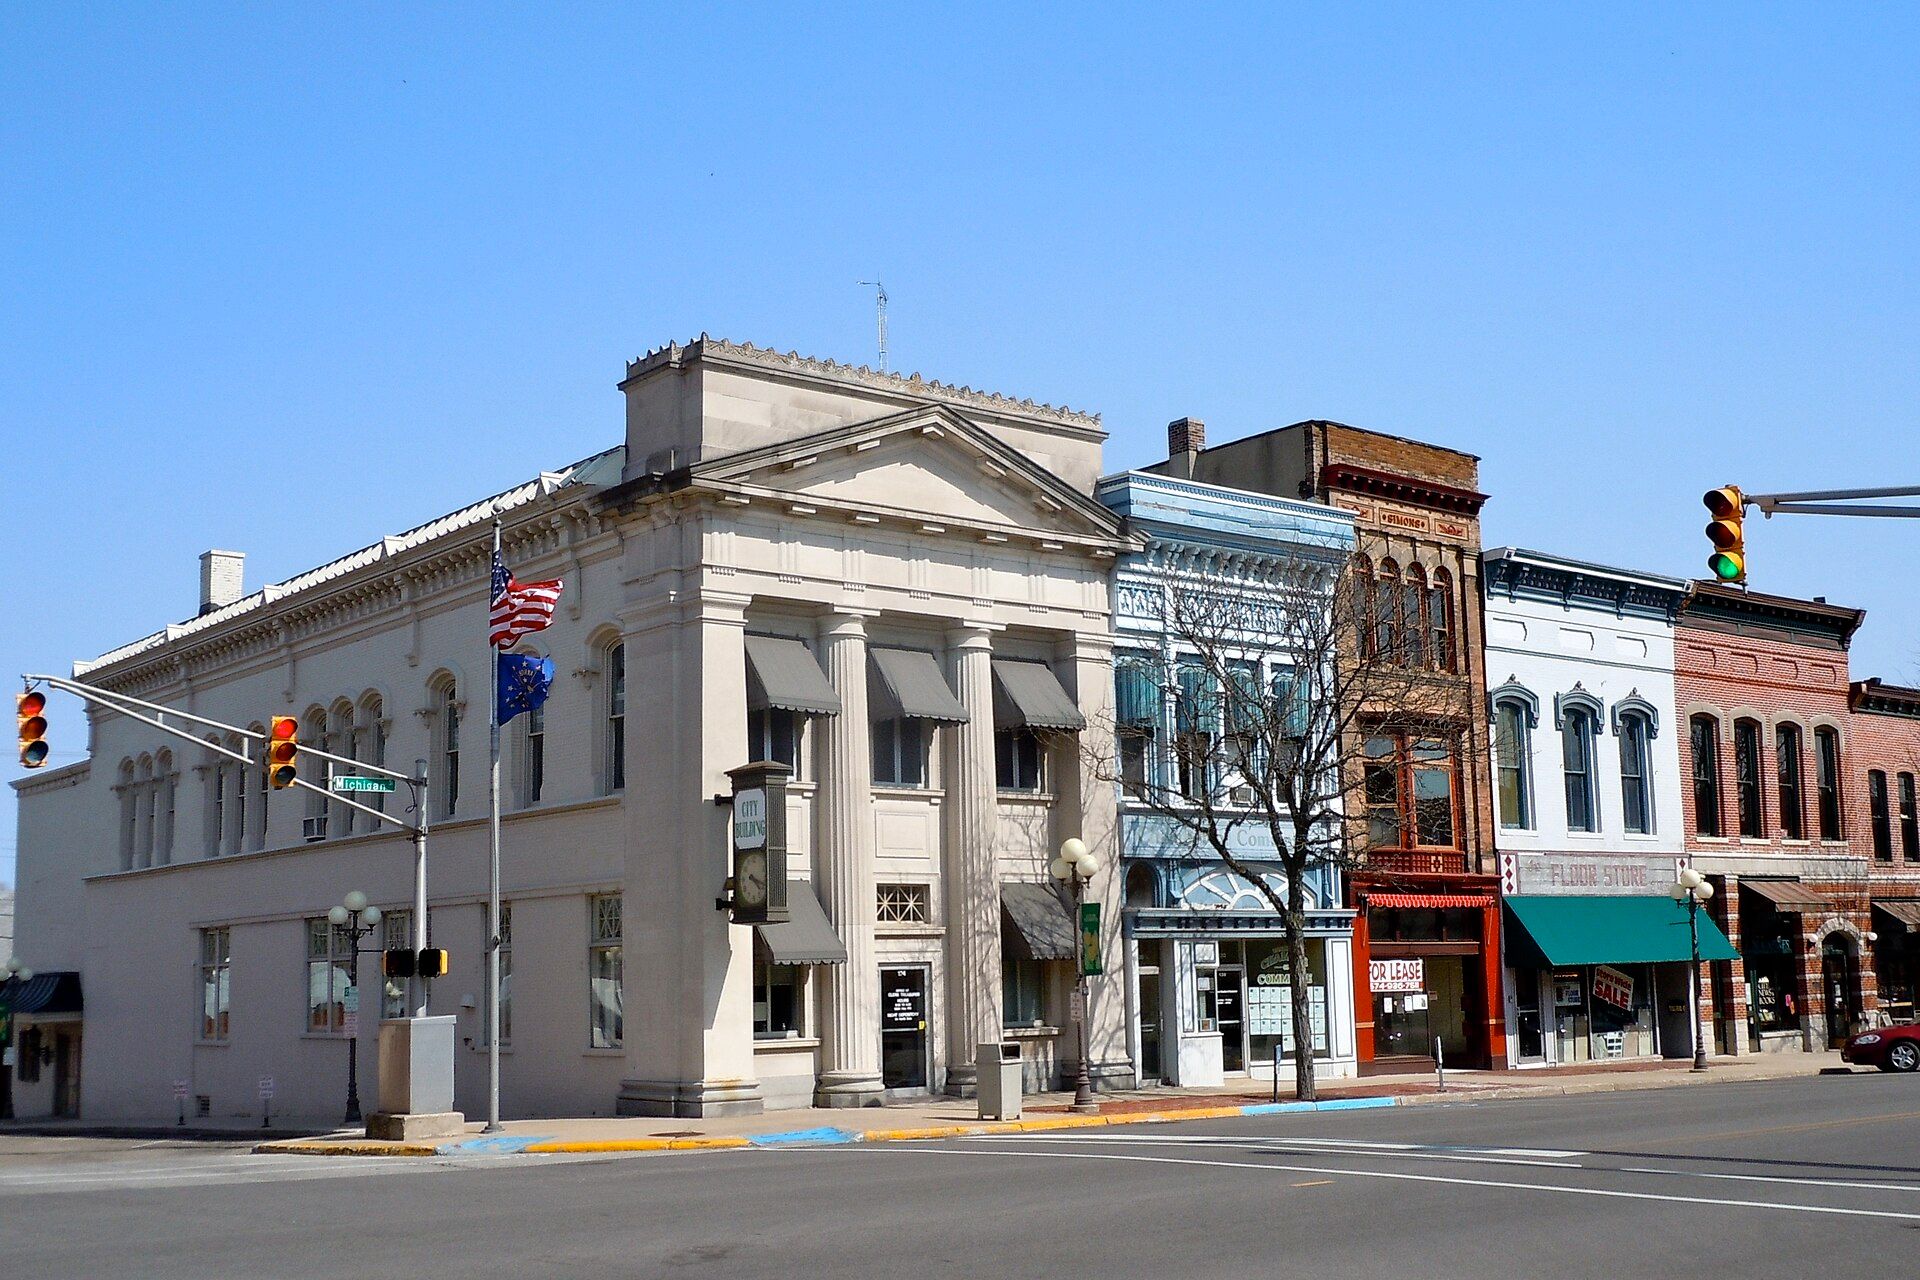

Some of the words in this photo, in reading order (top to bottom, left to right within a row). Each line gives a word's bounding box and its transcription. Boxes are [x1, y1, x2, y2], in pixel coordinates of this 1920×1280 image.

[1387, 514, 1420, 529] SIMONS
[336, 777, 386, 791] Michigan
[741, 800, 759, 818] CITY
[735, 820, 765, 839] BUILDING
[1551, 863, 1598, 887] FLOOR
[1604, 864, 1648, 887] STORE
[1257, 973, 1313, 985] COMME
[1390, 962, 1421, 981] LEASE
[1595, 979, 1630, 1010] SALE
[1758, 997, 1776, 1005] BOOKS
